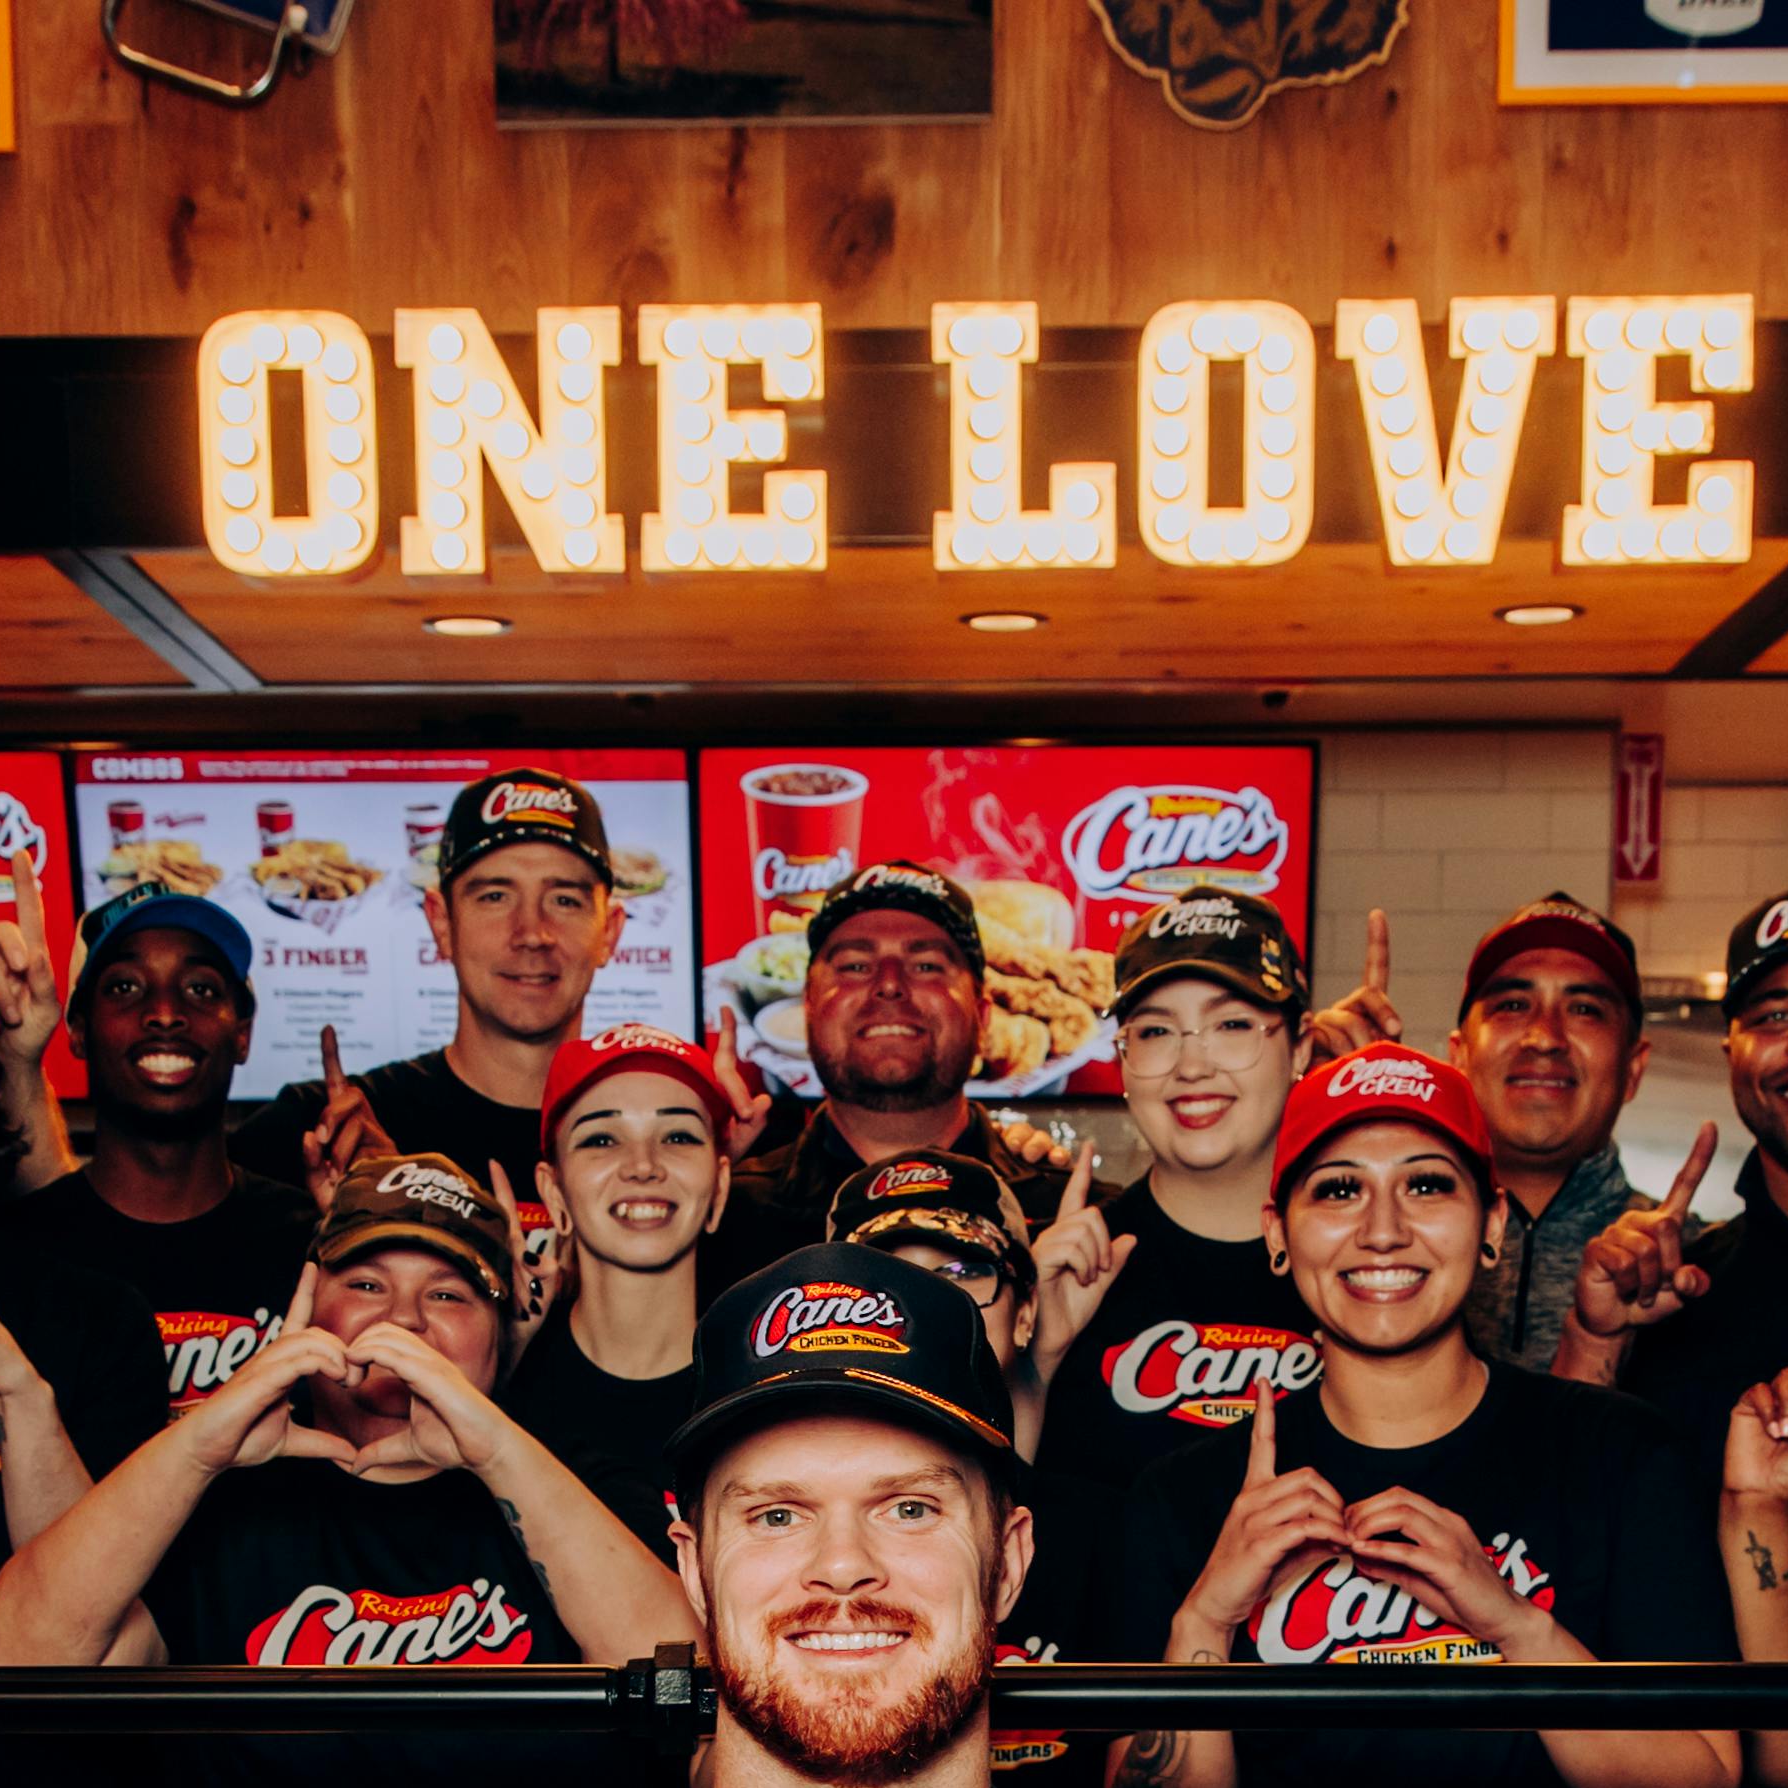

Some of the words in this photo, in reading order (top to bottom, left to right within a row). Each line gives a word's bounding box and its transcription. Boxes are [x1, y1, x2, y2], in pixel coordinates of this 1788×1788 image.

[197, 304, 828, 576] ONE
[930, 294, 1754, 572] LOVE
[92, 757, 185, 781] COMBOS
[482, 782, 579, 825] Cane's
[1075, 786, 1282, 892] Cane's
[1174, 917, 1247, 939] CREW
[283, 948, 367, 966] FINGER
[1359, 1078, 1441, 1103] CREW
[866, 1163, 953, 1200] Cane's
[405, 1183, 480, 1219] CREW
[806, 1283, 862, 1299] Raising
[755, 1287, 905, 1358] Cane's
[799, 1333, 849, 1350] CHICKEN
[1203, 1328, 1287, 1348] Raising
[359, 1593, 451, 1617] Raising
[258, 1578, 528, 1665] Cane's
[1357, 1649, 1437, 1663] CHICKEN
